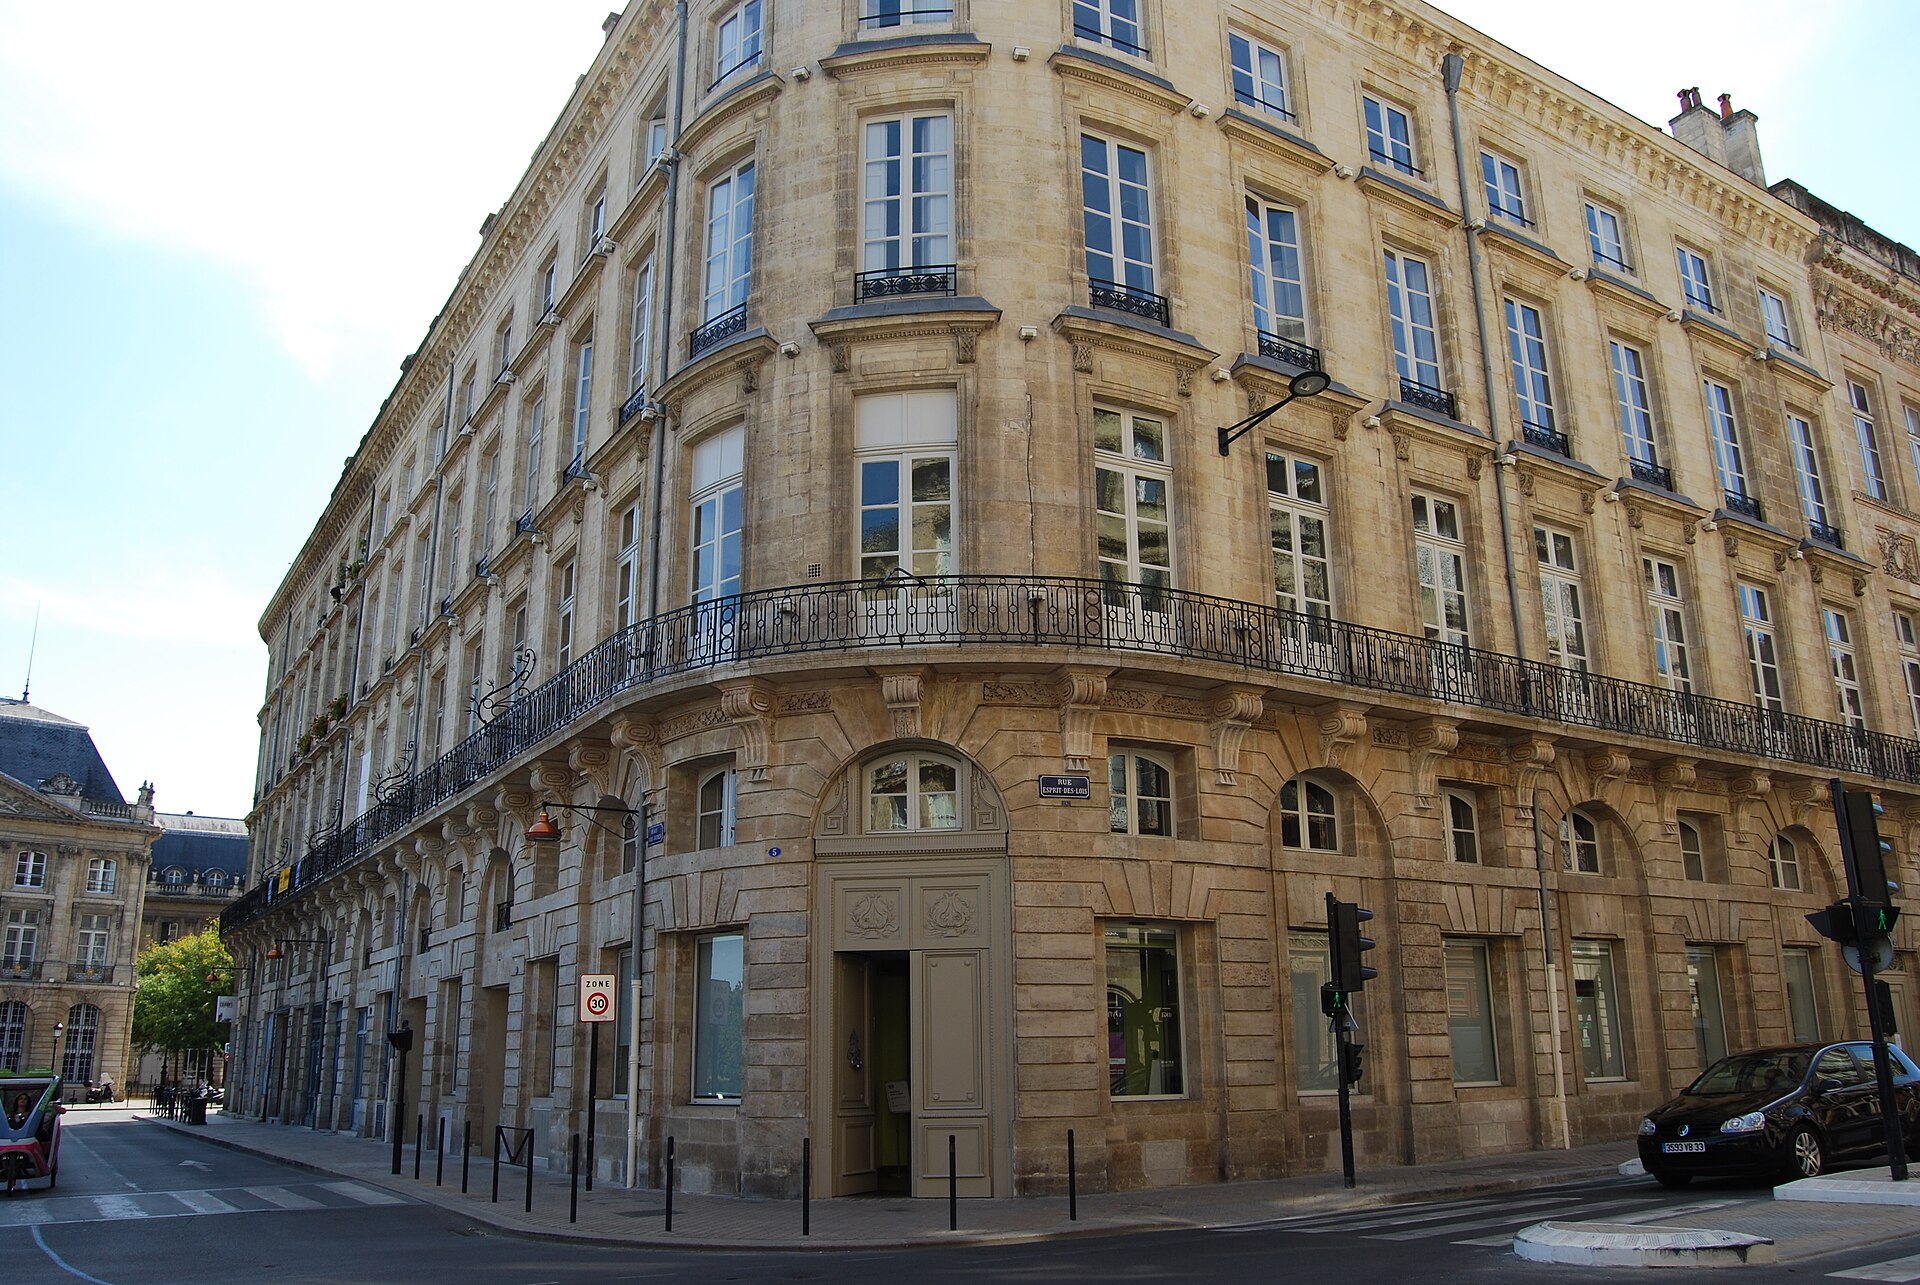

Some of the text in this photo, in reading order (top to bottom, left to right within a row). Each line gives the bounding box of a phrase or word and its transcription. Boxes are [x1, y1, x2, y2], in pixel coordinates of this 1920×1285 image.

[586, 980, 610, 988] ZONE
[591, 999, 605, 1009] 30
[1666, 1143, 1683, 1152] 3593
[1694, 1142, 1704, 1151] 33
